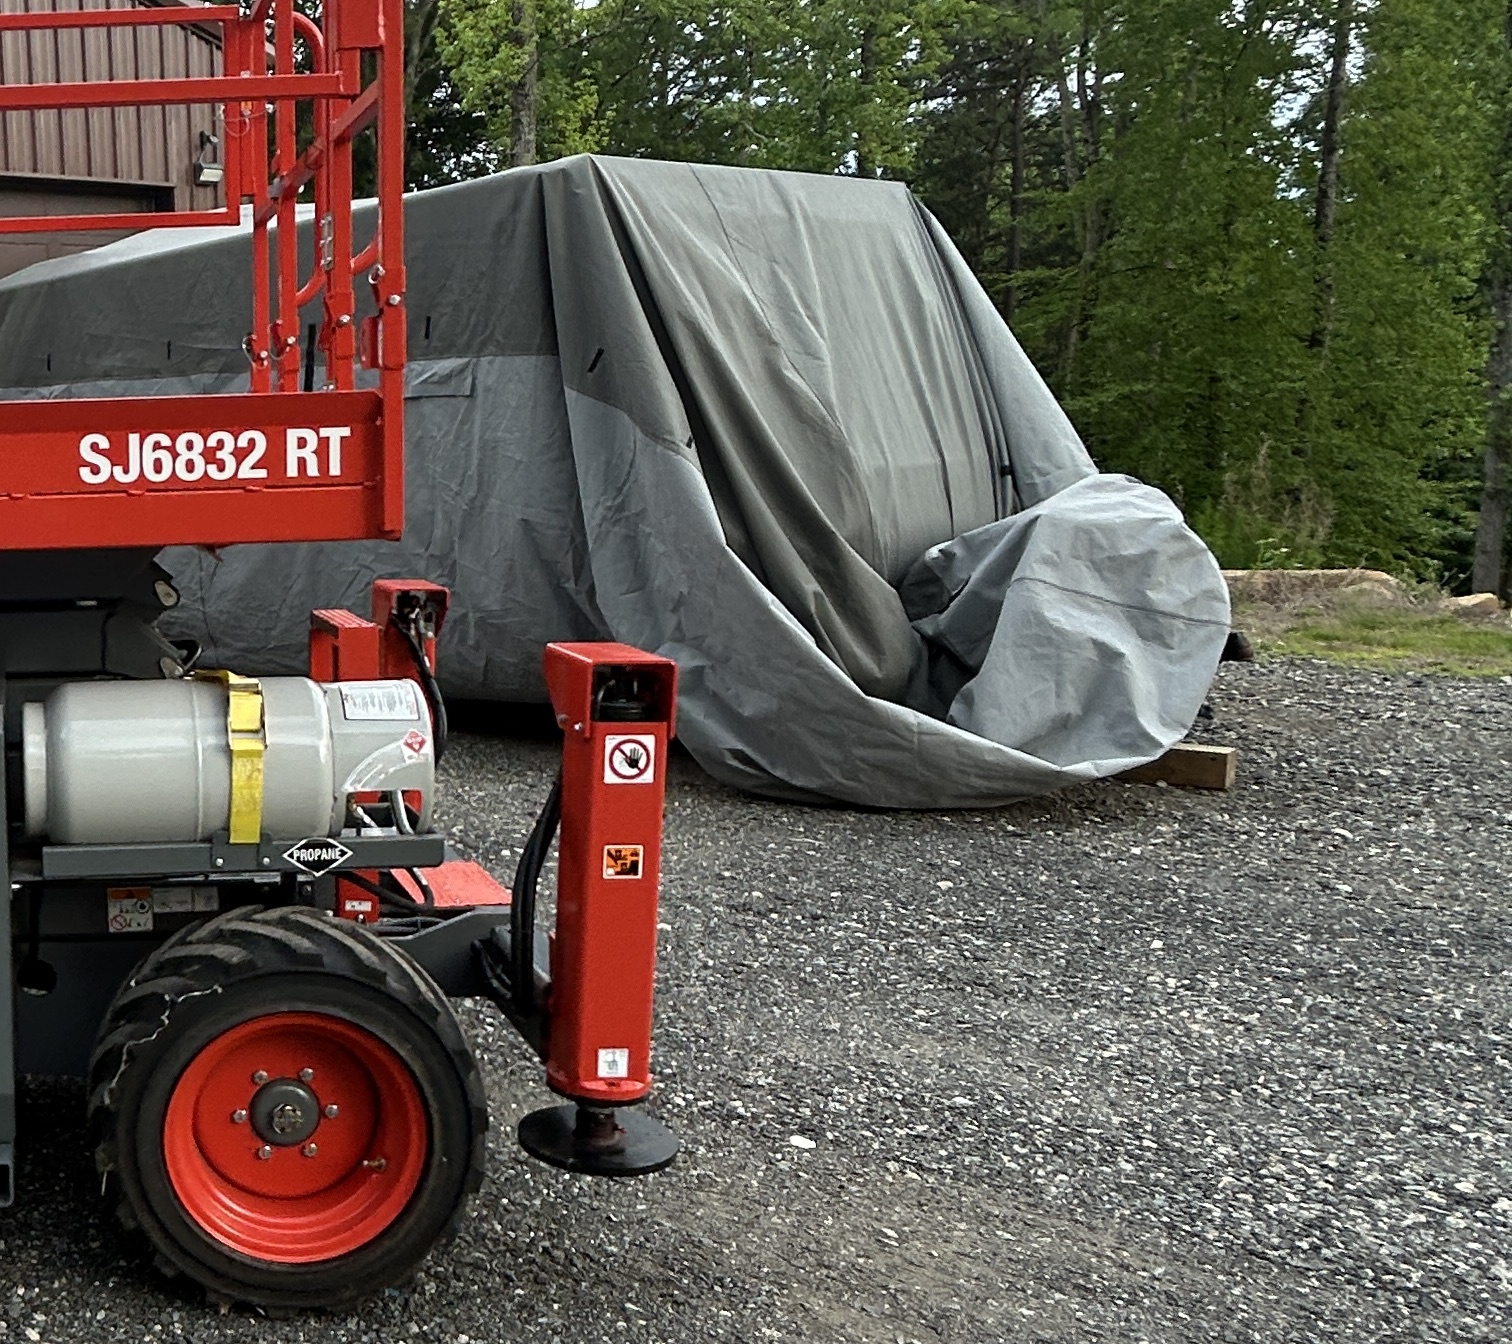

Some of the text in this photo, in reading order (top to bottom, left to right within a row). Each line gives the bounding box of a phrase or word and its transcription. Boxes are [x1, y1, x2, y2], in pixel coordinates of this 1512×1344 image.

[78, 426, 352, 485] SJ6832 RT
[292, 847, 342, 862] PROPANE
